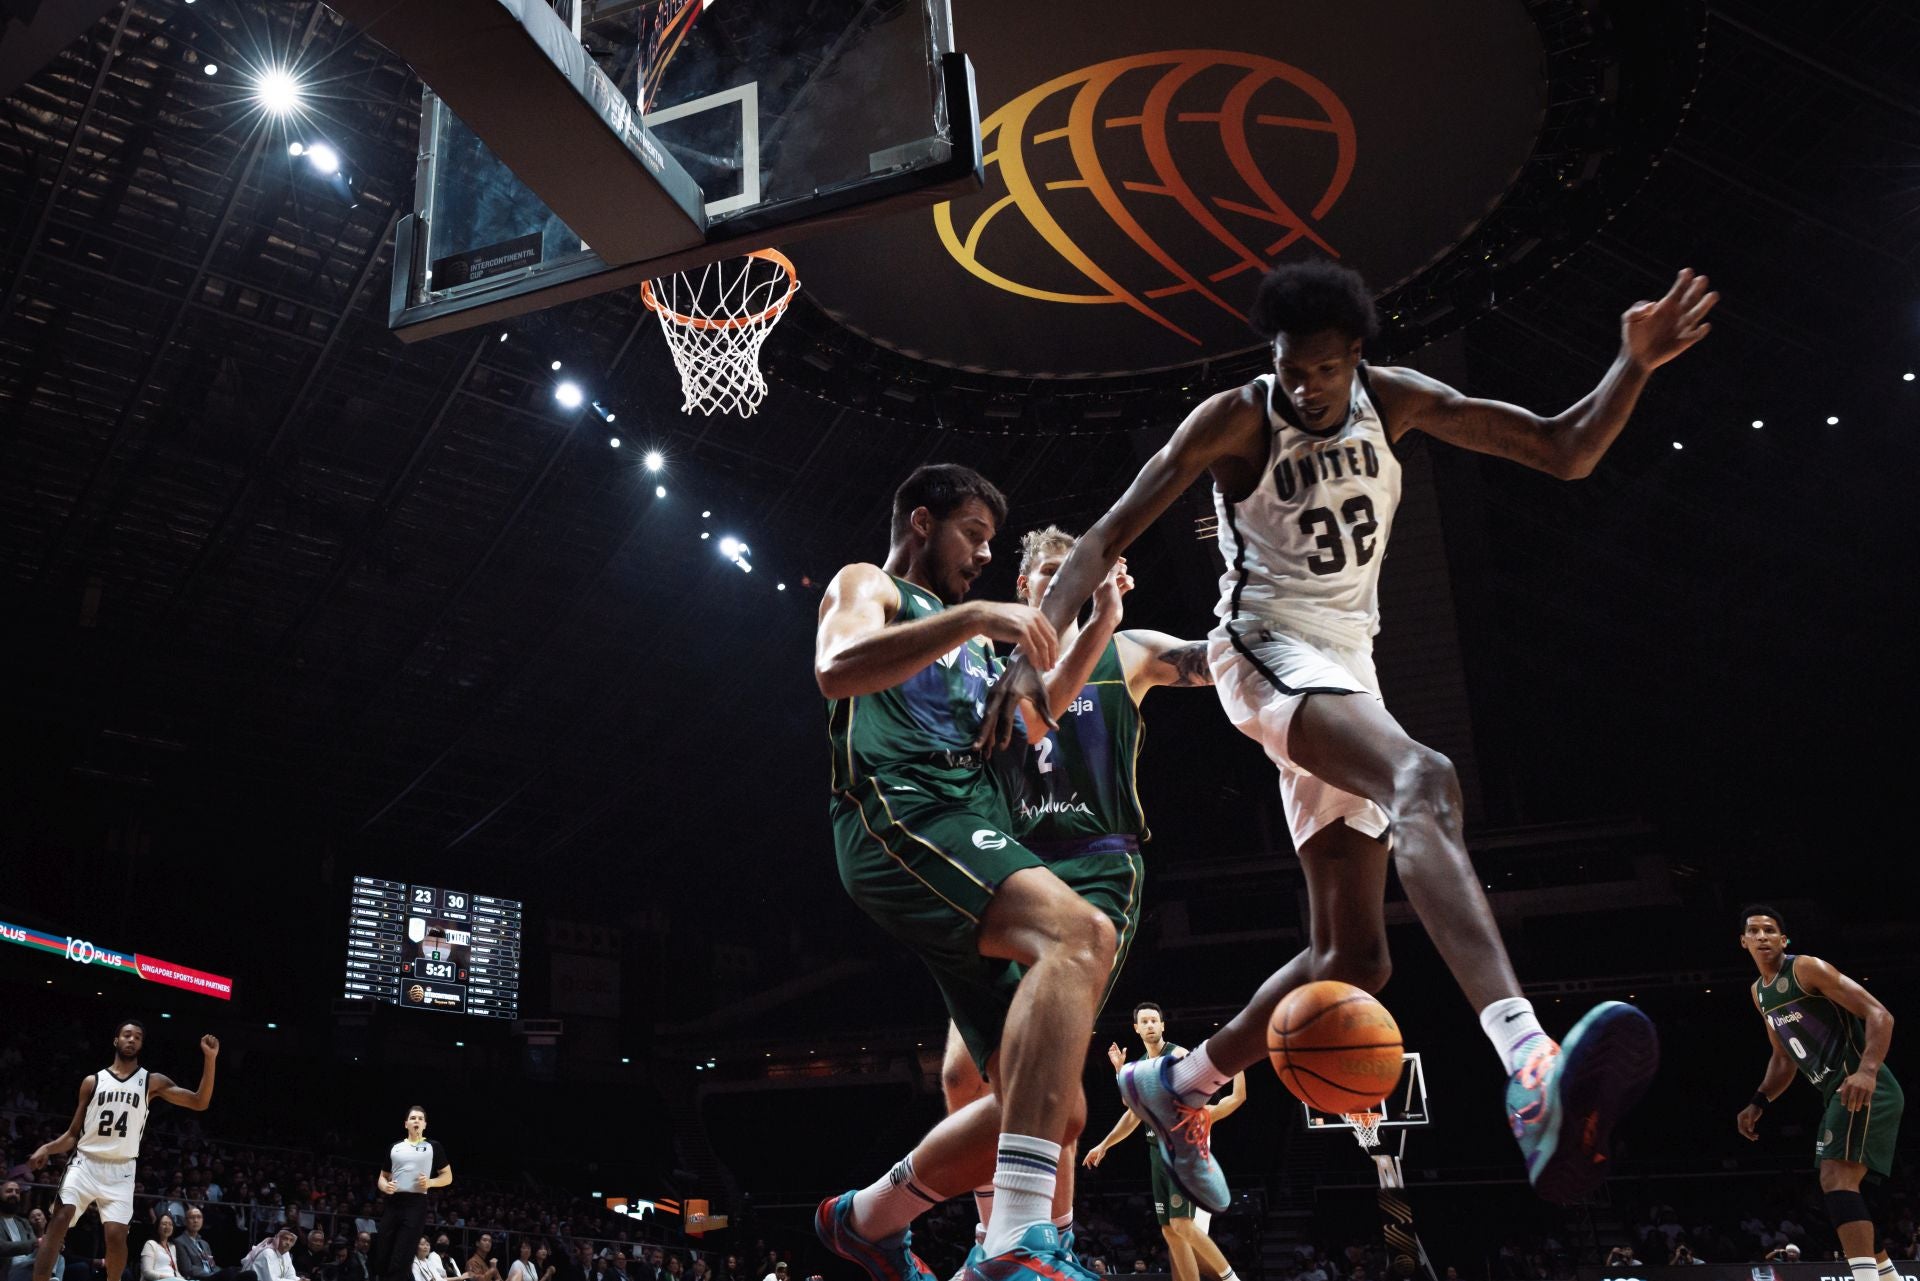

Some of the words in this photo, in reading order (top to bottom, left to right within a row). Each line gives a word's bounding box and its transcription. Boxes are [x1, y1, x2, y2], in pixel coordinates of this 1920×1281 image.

[470, 248, 536, 273] INTERCONTINENTAL
[469, 269, 484, 281] CUP
[1273, 440, 1379, 502] UNITED
[1298, 494, 1378, 577] 32
[1067, 696, 1094, 716] aja
[415, 889, 432, 904] 23
[448, 895, 465, 909] 30
[434, 952, 440, 960] 2
[141, 963, 173, 978] SINGAPORE
[173, 971, 195, 984] SPORTS
[194, 976, 206, 987] HUB
[205, 980, 231, 993] PARTNERS
[426, 963, 453, 978] 5:21
[1774, 1010, 1804, 1028] Unicaja
[1789, 1037, 1807, 1060] 0
[98, 1090, 141, 1109] UNITED
[98, 1109, 129, 1138] 24
